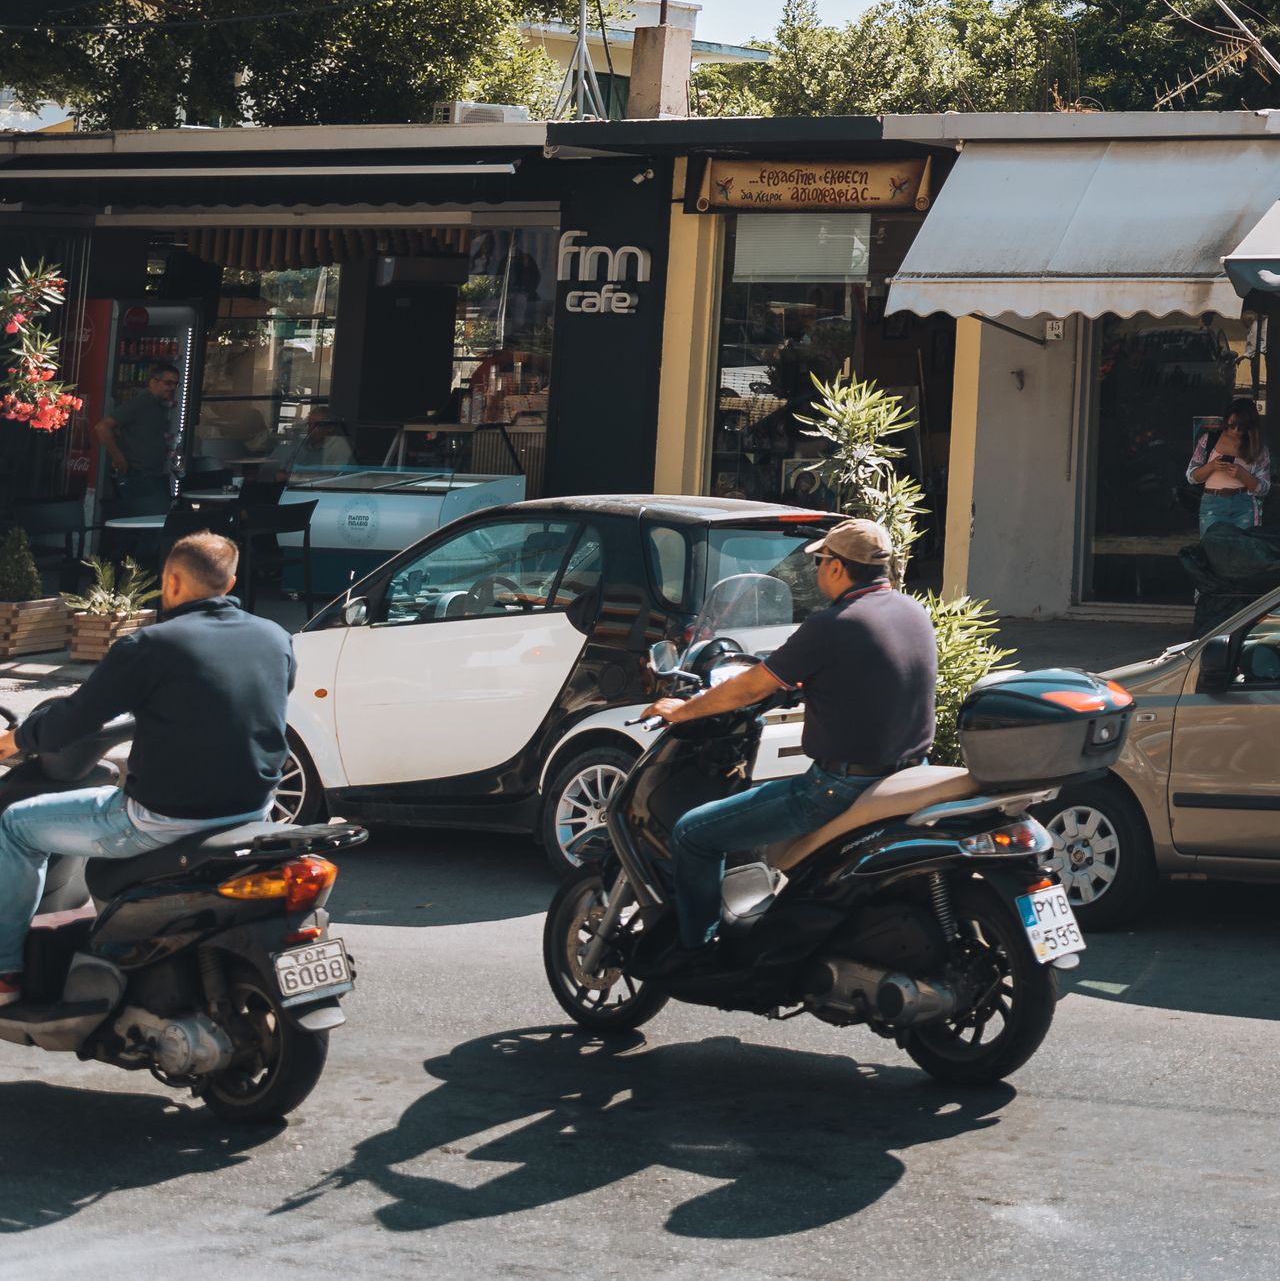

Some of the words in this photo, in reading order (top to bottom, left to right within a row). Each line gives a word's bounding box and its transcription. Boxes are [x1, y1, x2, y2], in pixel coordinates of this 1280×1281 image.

[566, 284, 638, 313] cafe
[1048, 321, 1060, 332] 45
[1034, 895, 1069, 922] PYB
[1043, 923, 1080, 950] 555
[284, 959, 344, 991] 6088
